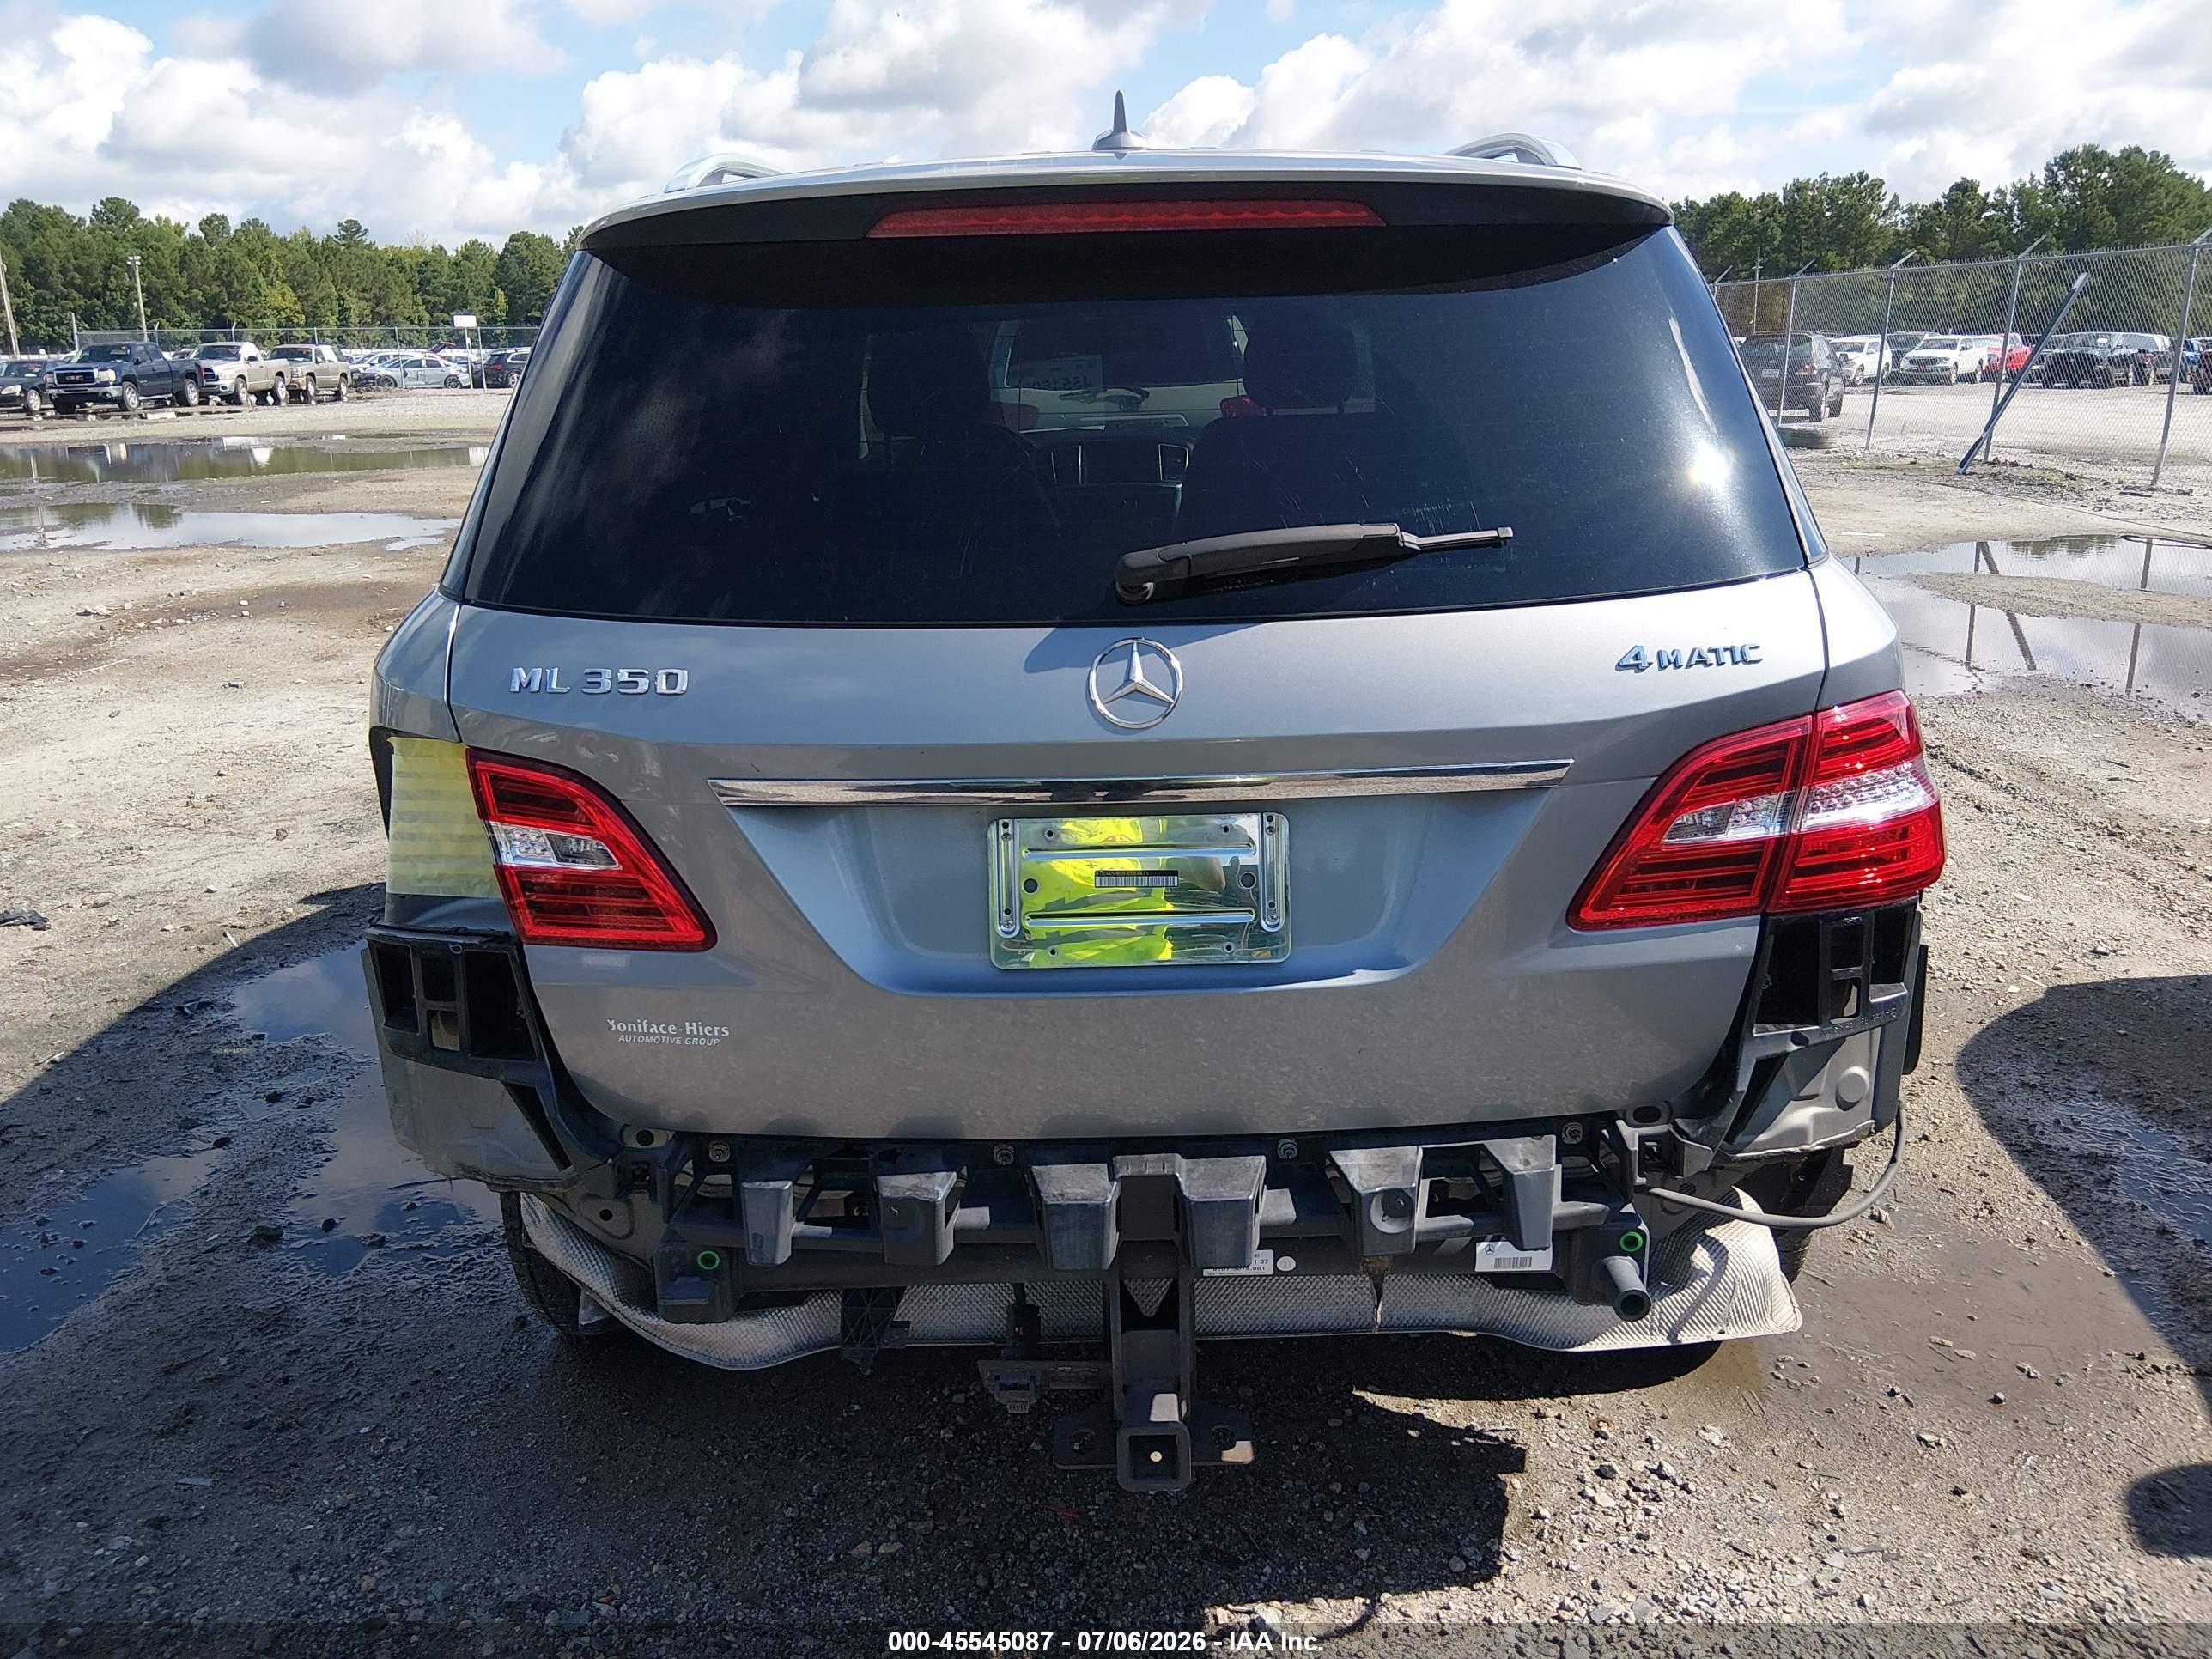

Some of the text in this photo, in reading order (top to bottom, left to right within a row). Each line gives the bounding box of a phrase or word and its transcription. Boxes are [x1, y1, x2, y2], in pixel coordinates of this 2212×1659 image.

[509, 666, 689, 696] ML 350
[618, 1034, 720, 1046] AUTOMOTIVE GROUP
